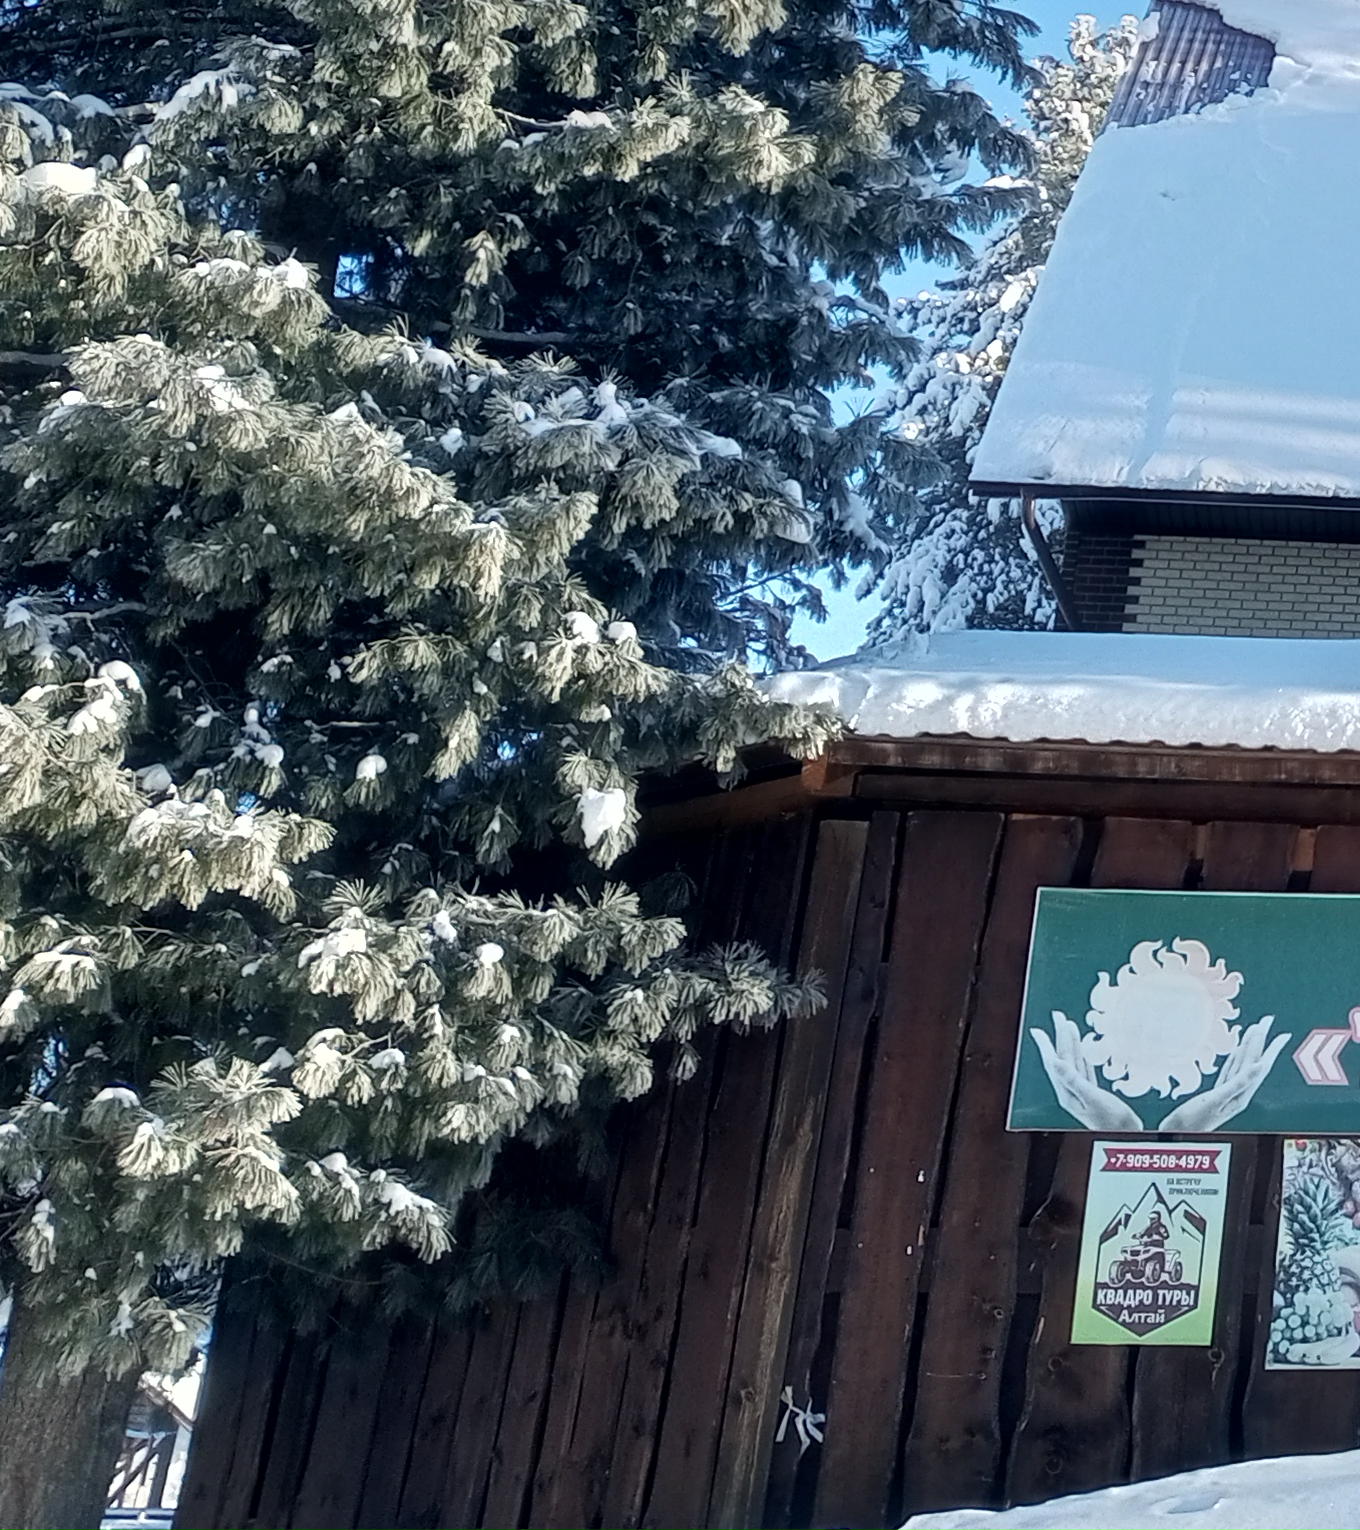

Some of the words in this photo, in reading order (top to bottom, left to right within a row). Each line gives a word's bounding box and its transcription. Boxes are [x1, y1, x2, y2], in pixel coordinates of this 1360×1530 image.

[1096, 1288, 1153, 1308] КВАДРО
[1157, 1289, 1195, 1306] ТУРЫ
[1118, 1309, 1165, 1324] Алтай
